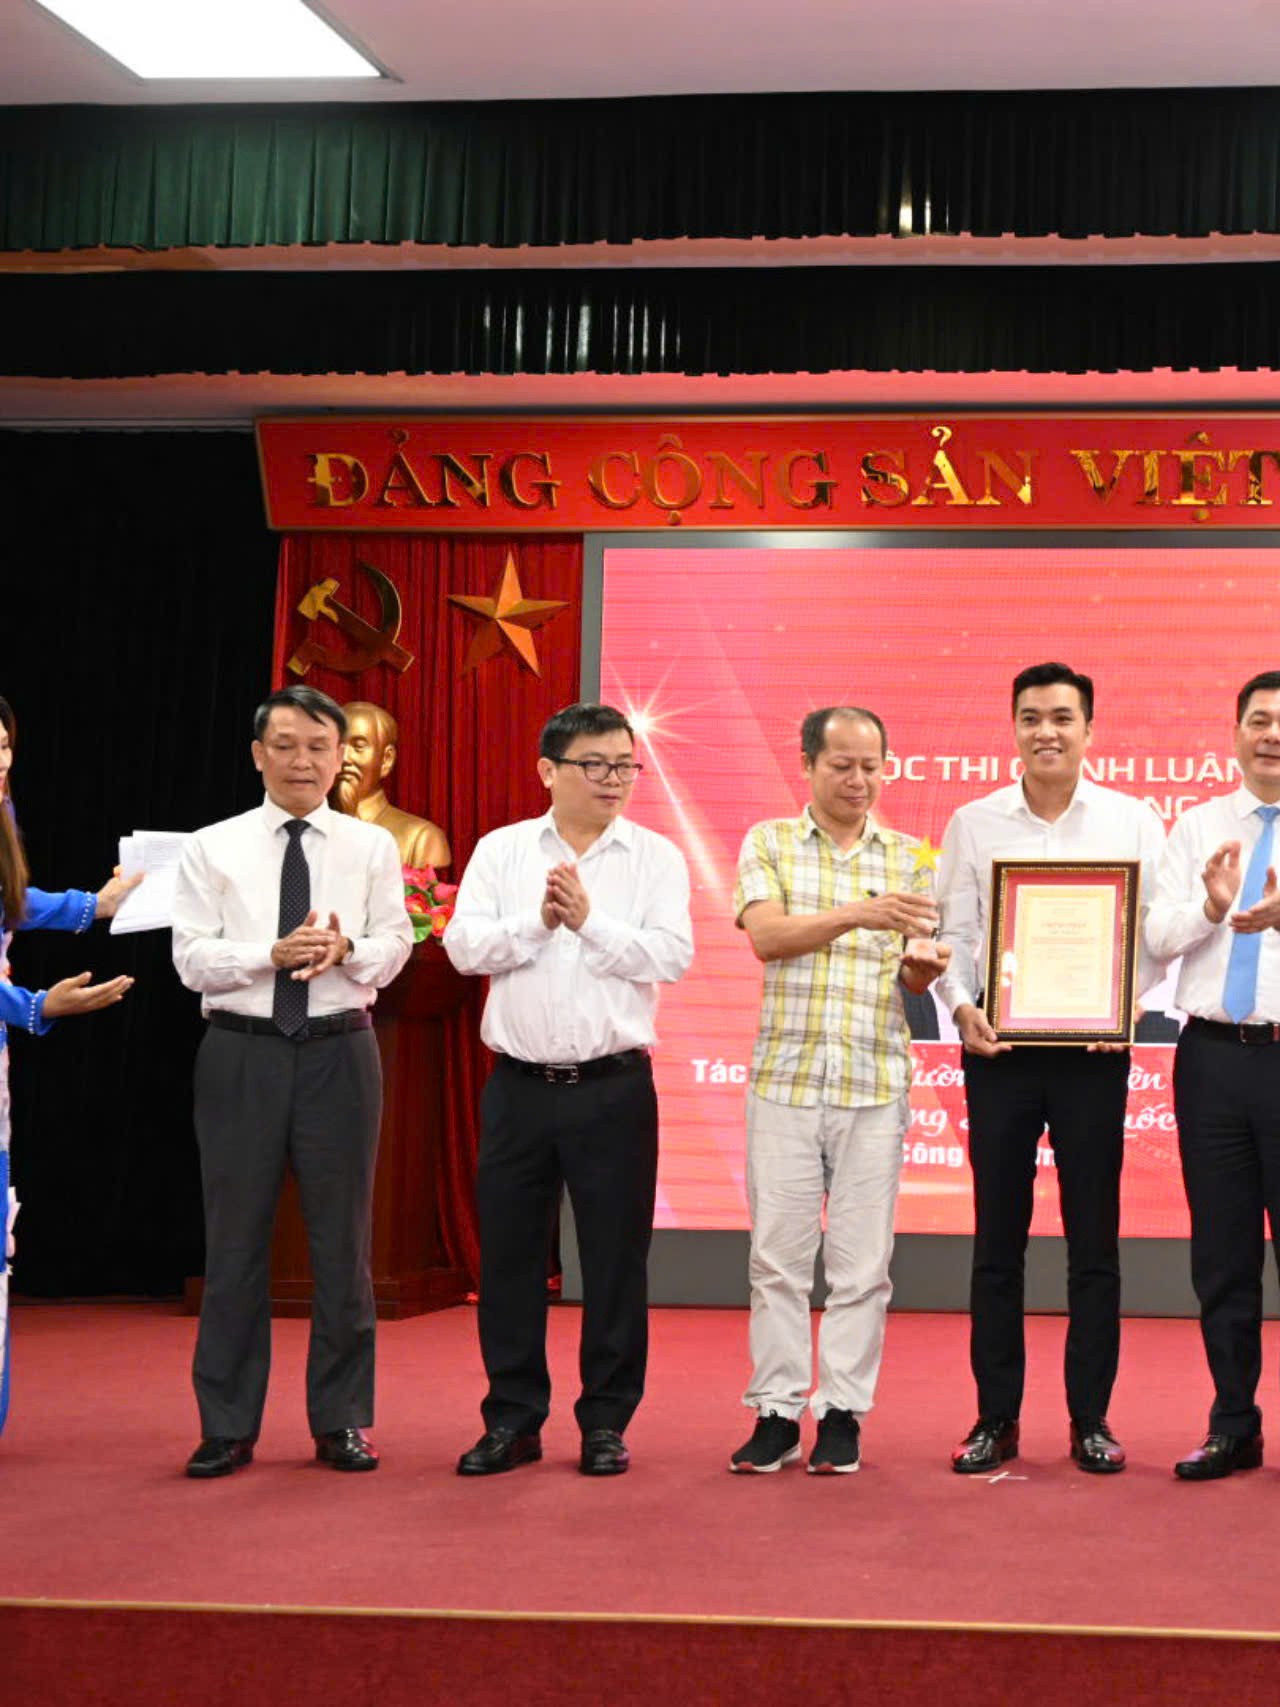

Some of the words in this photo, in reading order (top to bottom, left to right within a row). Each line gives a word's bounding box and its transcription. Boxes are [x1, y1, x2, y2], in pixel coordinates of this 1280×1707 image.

[306, 427, 562, 508] ĐẢNG
[586, 432, 838, 525] CỘNG
[859, 425, 1034, 505] SẢN
[935, 756, 1000, 782] THI
[690, 1057, 746, 1083] Tác
